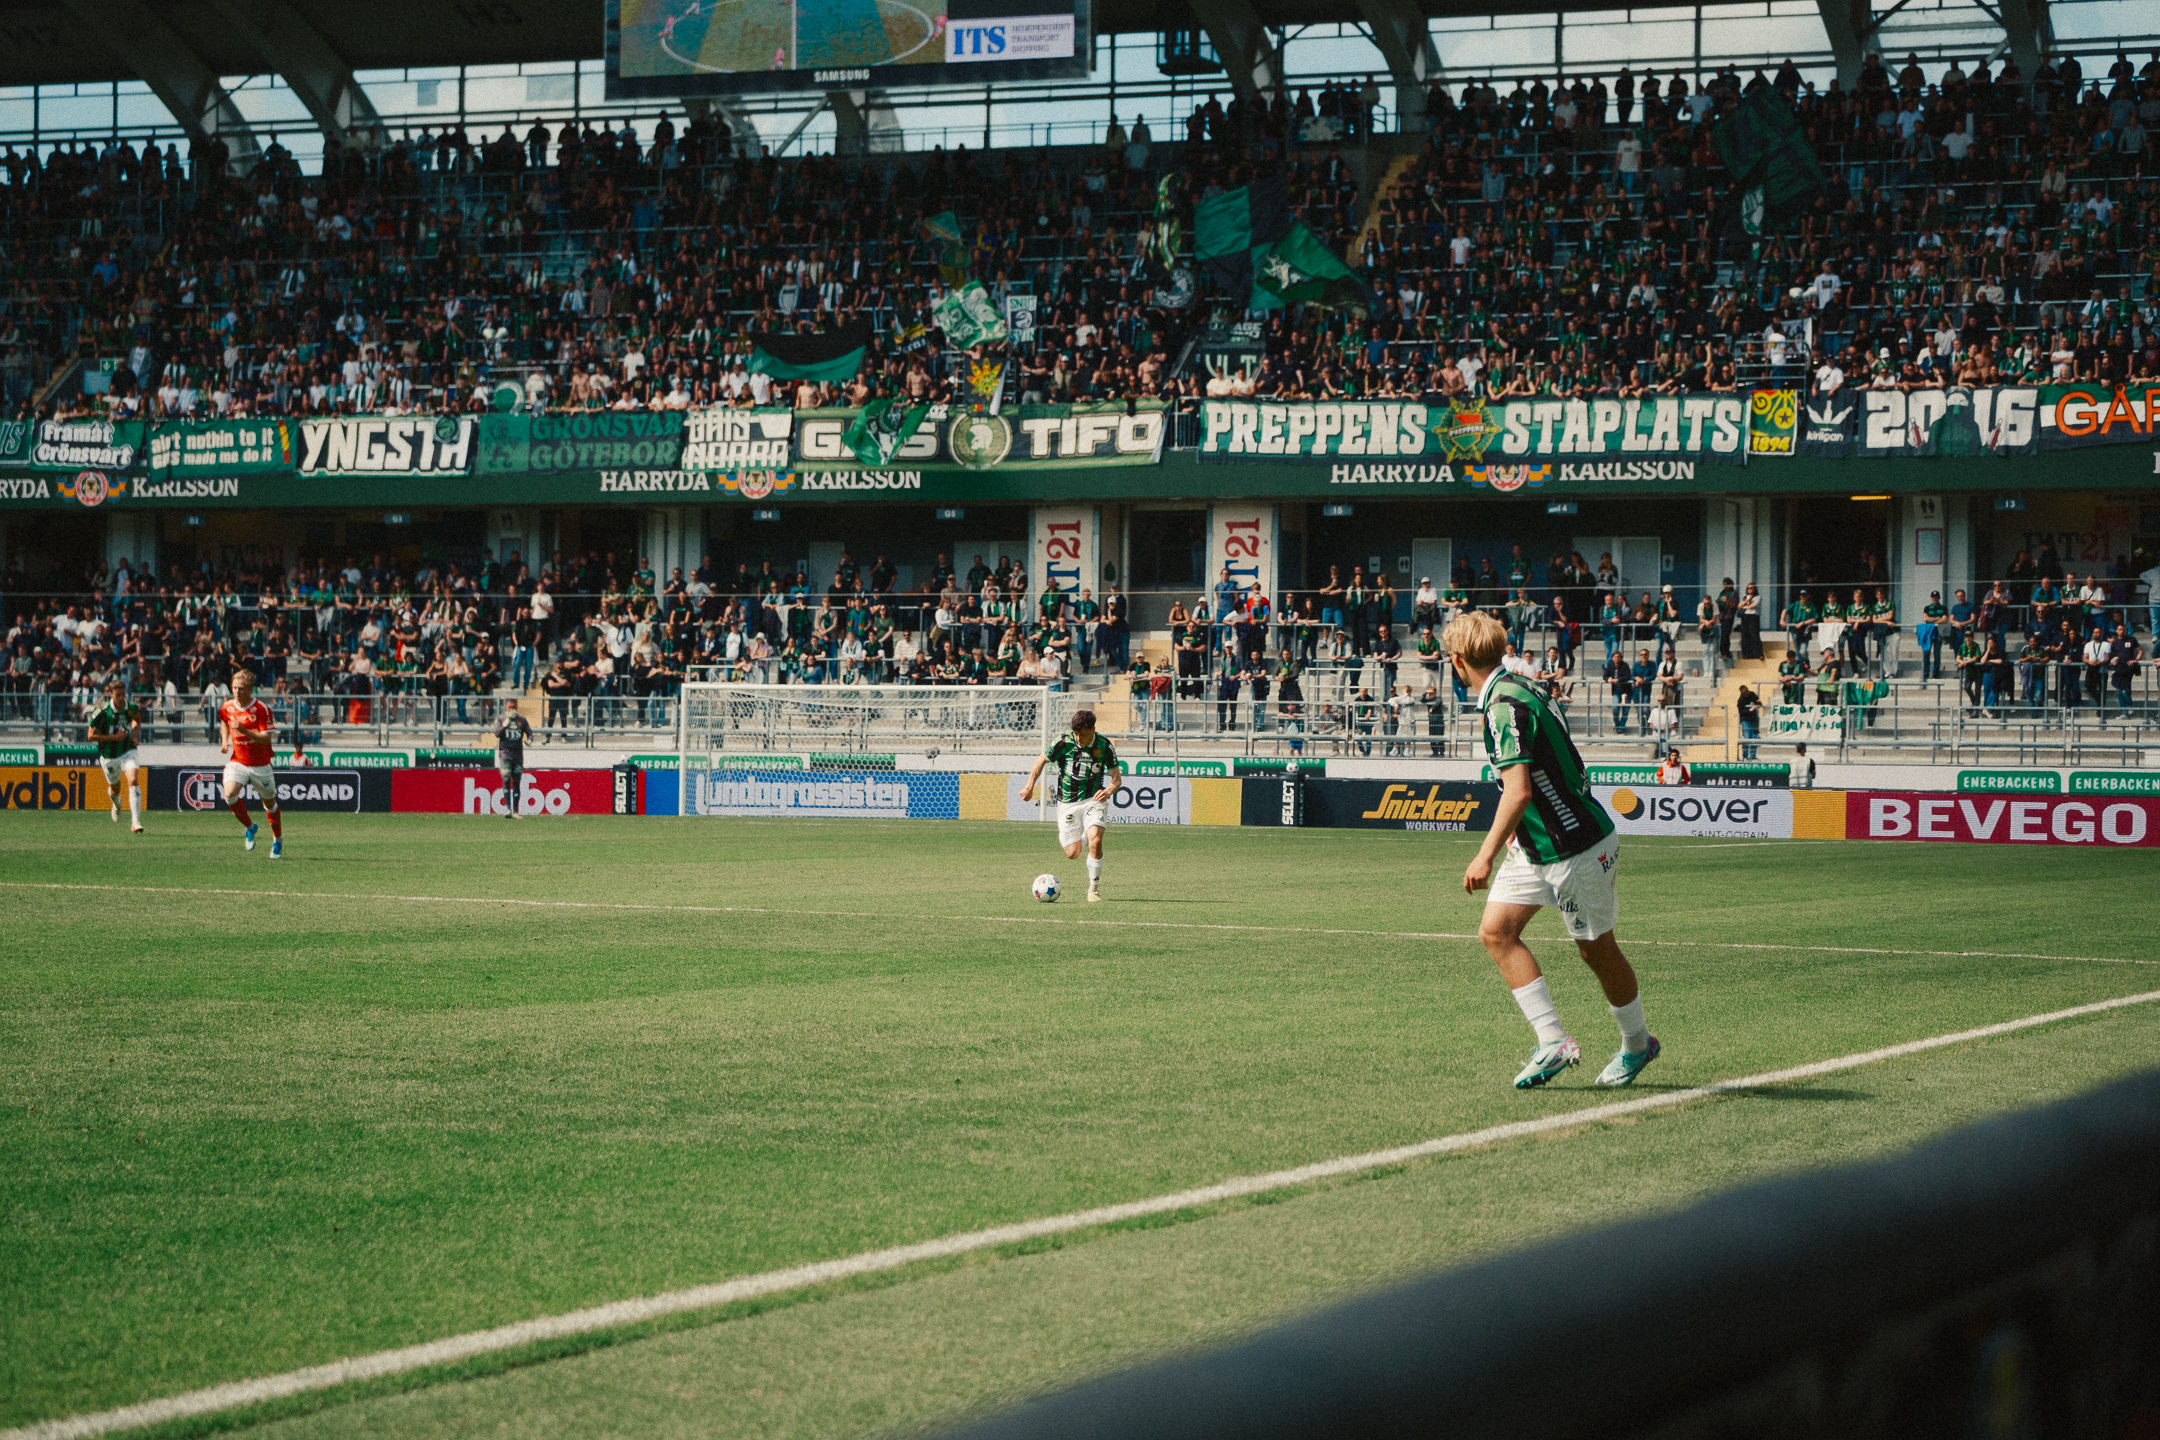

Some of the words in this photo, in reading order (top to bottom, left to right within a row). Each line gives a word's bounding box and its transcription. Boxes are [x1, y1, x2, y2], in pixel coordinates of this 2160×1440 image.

[954, 26, 1006, 55] ITS
[814, 69, 870, 82] SAMSUNG
[1022, 412, 1164, 457] TIFO
[1203, 402, 1428, 455] PREPPENS
[1501, 397, 1742, 455] STAPLATS
[239, 428, 257, 447] to
[1753, 436, 1791, 452] 1894
[183, 450, 217, 466] made
[219, 450, 239, 464] me
[242, 447, 260, 463] do
[802, 470, 921, 491] KARLSSON
[1559, 461, 1694, 481] KARLSSON
[333, 756, 405, 767] ENERBACKENS
[1591, 771, 1660, 784] ENERBACKE
[1963, 776, 2055, 789] ENERBACKENS
[2075, 777, 2160, 791] ENERBACKEN
[615, 771, 627, 814] SELECT
[1281, 781, 1295, 825] SELECT
[1362, 784, 1480, 821] Snickers
[1405, 820, 1467, 832] WORKWEAR
[1869, 798, 2148, 843] BEVEGO
